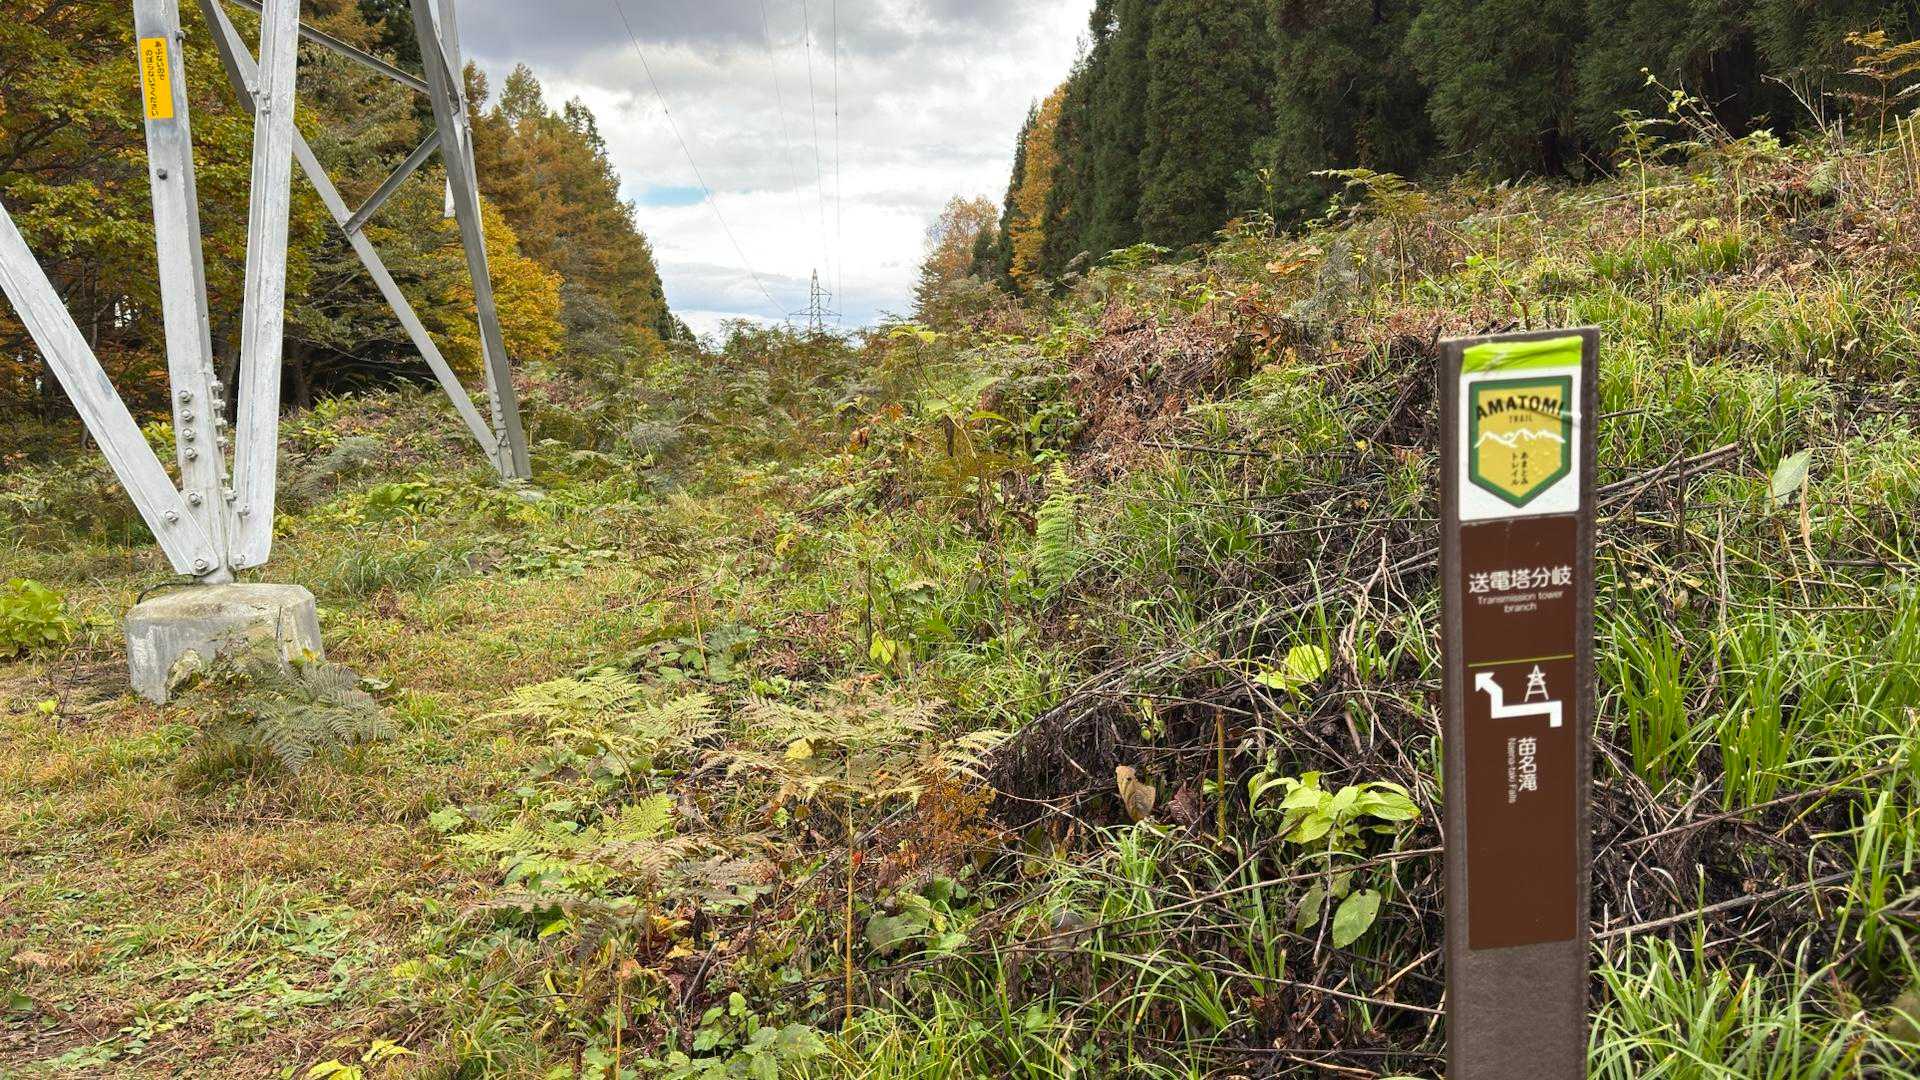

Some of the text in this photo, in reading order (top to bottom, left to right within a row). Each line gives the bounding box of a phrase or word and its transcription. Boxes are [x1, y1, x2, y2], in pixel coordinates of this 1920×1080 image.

[1509, 415, 1533, 424] TRAIL
[1468, 564, 1572, 593] 送電塔分岐
[1478, 591, 1563, 604] Transmission tower
[1504, 603, 1537, 613] branch
[1518, 737, 1537, 792] 苗名滝
[1508, 784, 1517, 803] Falls
